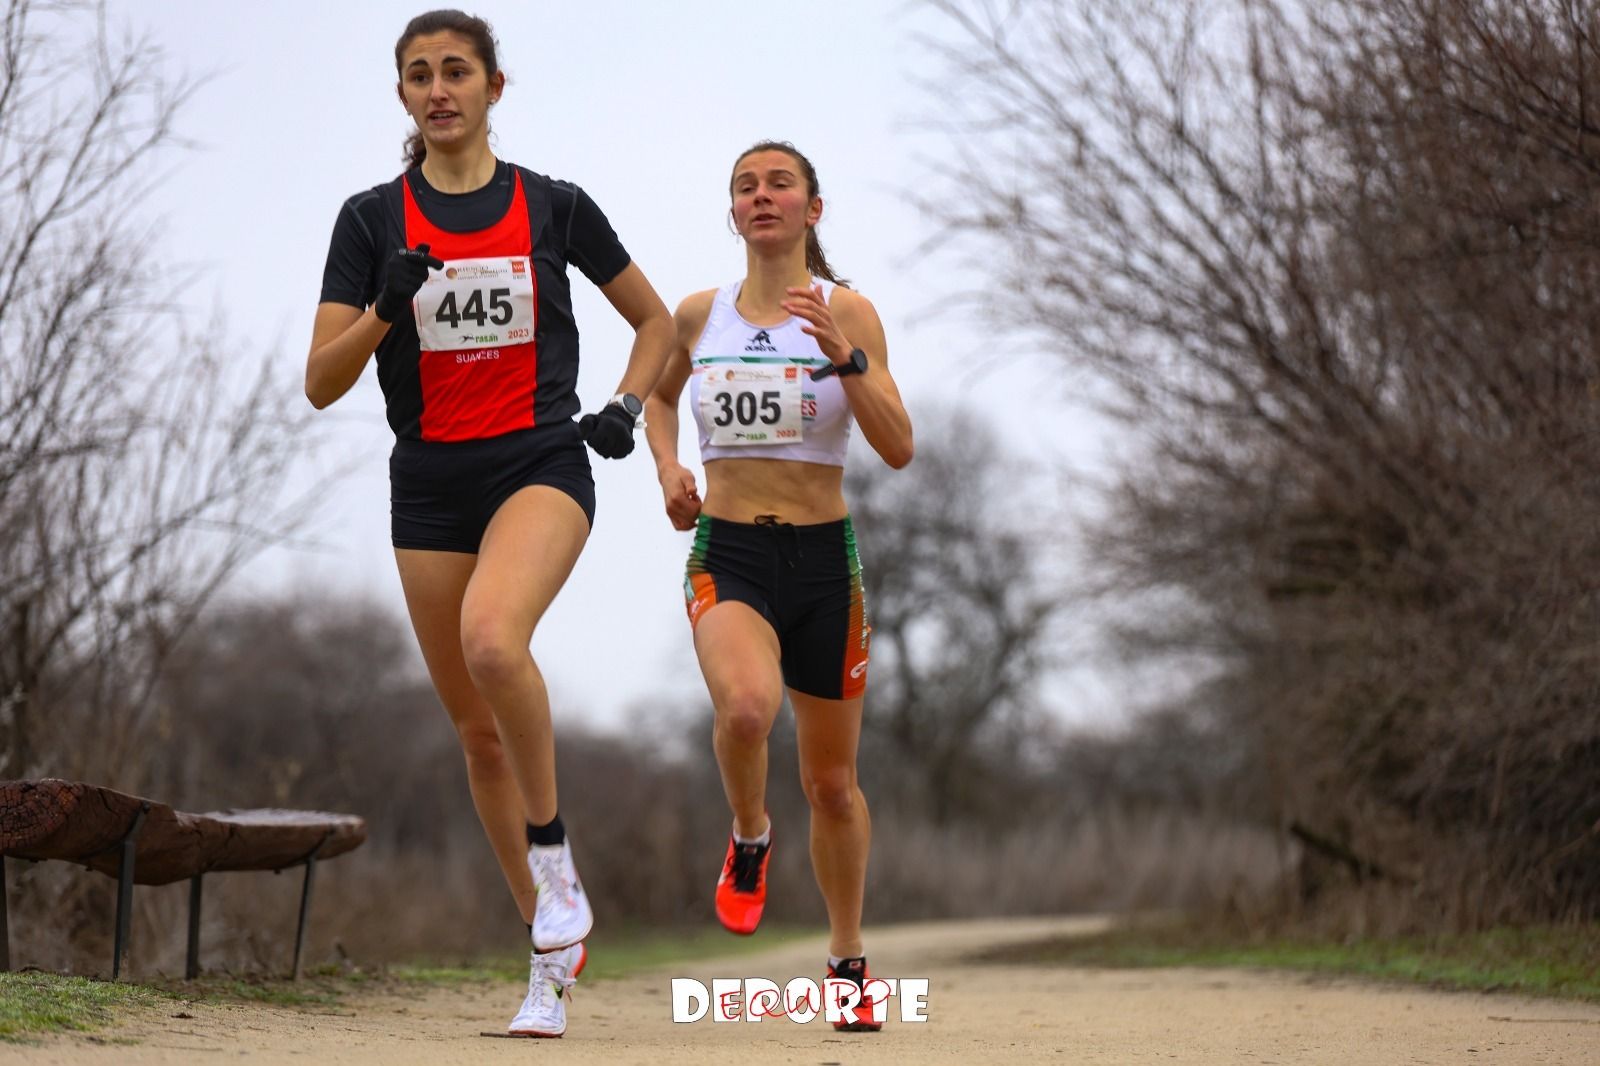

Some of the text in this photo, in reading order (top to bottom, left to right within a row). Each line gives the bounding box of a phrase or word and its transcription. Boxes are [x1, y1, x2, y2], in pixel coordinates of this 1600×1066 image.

[436, 288, 513, 328] 445
[508, 328, 529, 339] 2023
[714, 391, 781, 427] 305
